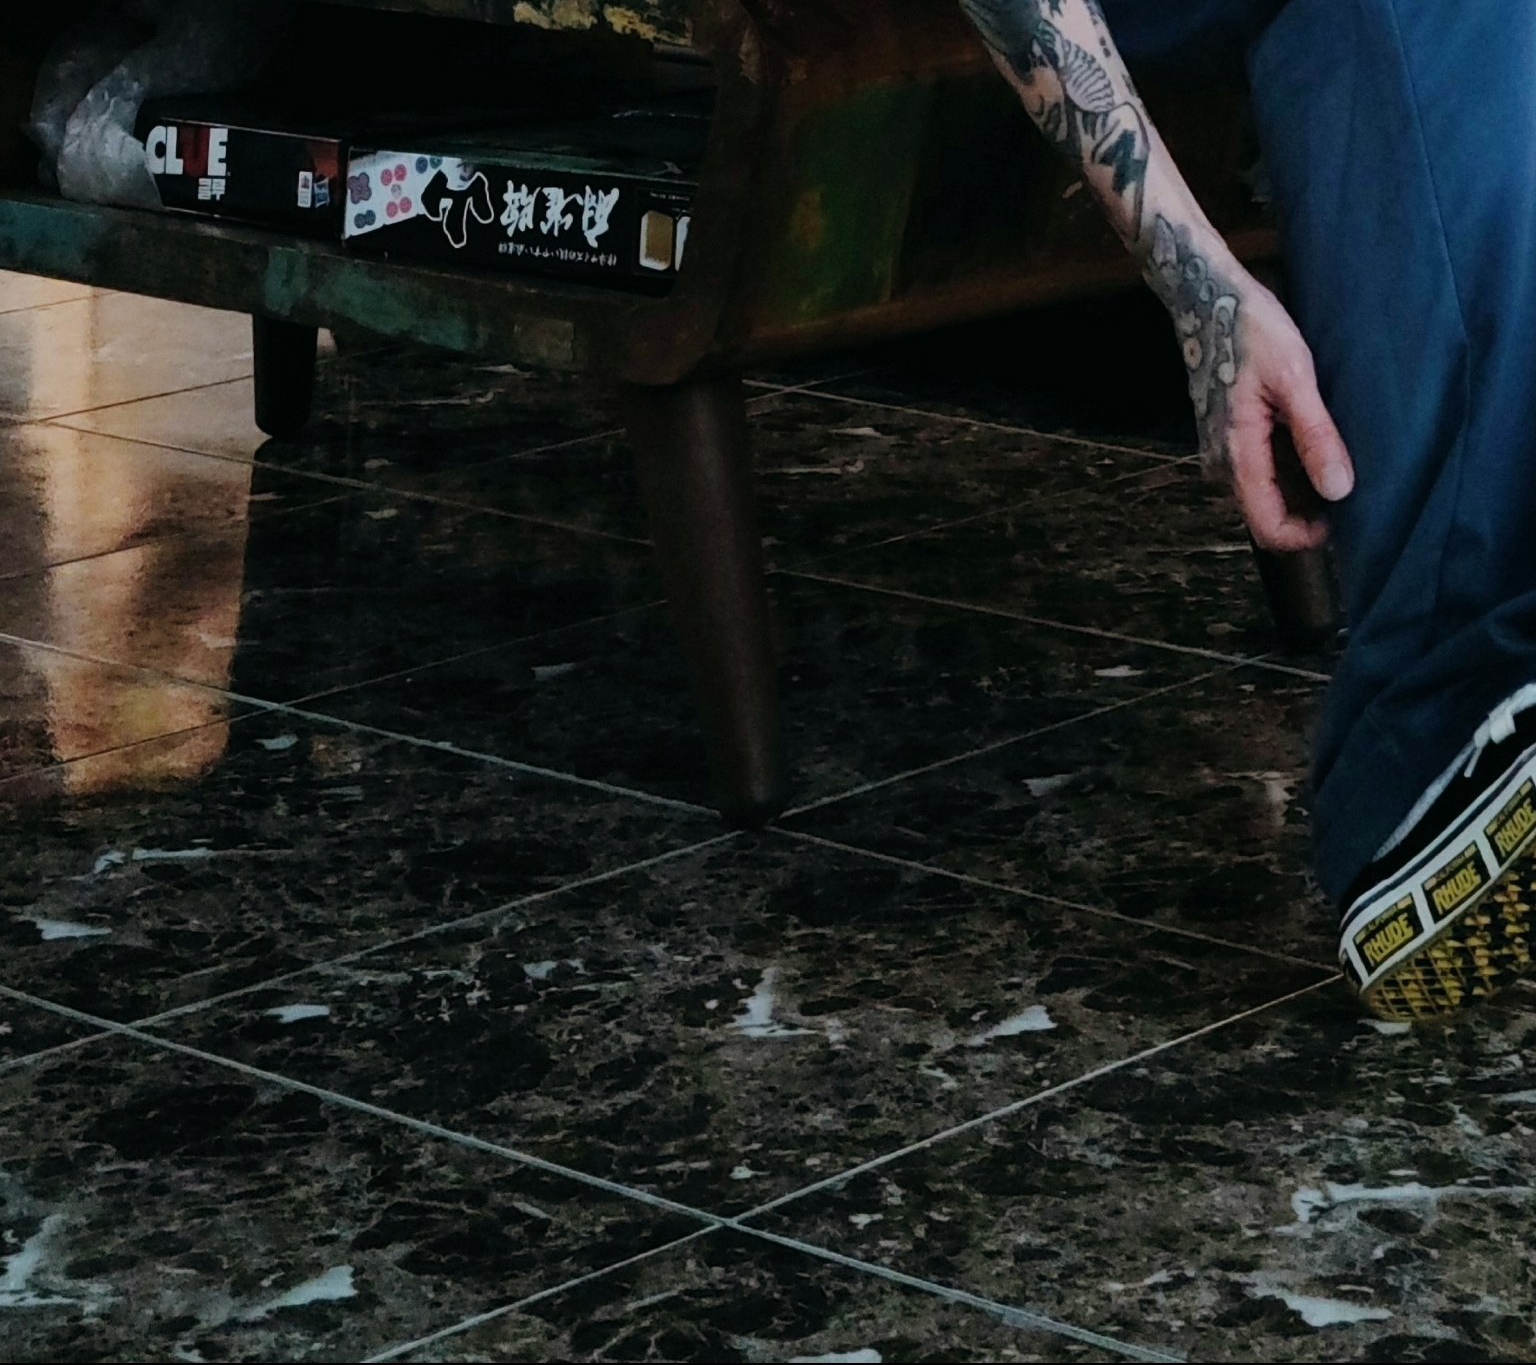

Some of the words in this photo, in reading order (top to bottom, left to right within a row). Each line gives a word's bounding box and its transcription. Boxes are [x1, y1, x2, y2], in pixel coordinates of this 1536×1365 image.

[146, 125, 228, 178] CLUE
[1432, 860, 1481, 916] RHUDE
[1363, 912, 1414, 967] RHUDE
